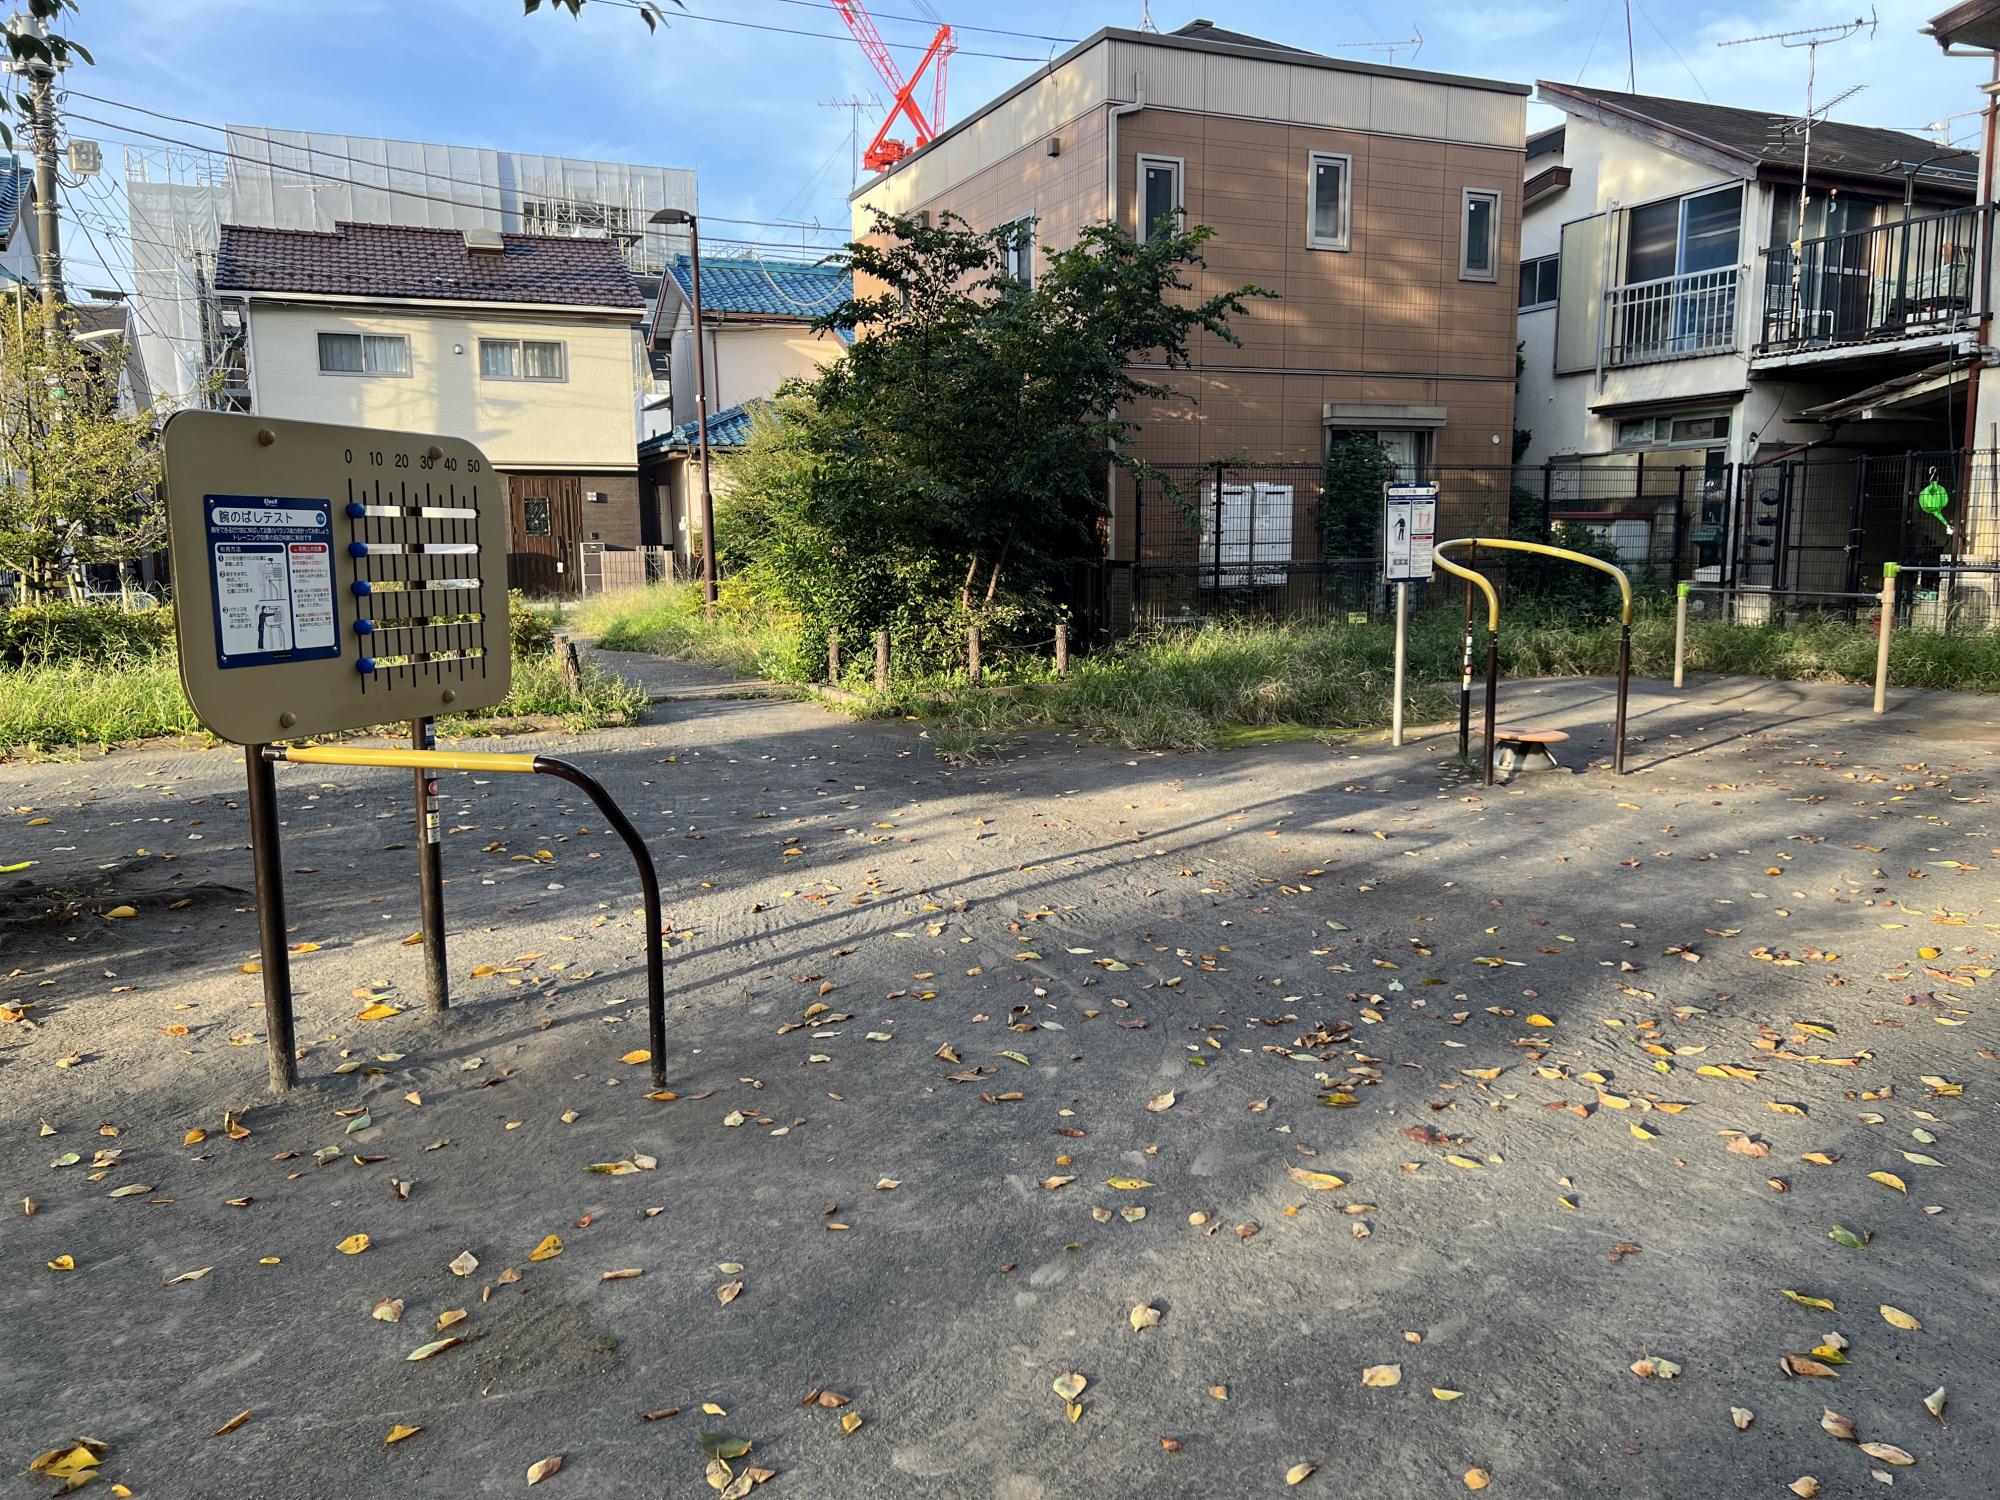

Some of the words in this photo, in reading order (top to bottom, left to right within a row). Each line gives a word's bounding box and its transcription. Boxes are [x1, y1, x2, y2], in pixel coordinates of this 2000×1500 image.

[344, 449, 353, 464] 0
[369, 451, 383, 466] 10
[395, 453, 409, 468] 20
[420, 455, 434, 470] 30
[444, 458, 457, 471] 40
[467, 459, 480, 473] 50
[219, 510, 293, 524] 腕のばしテスト
